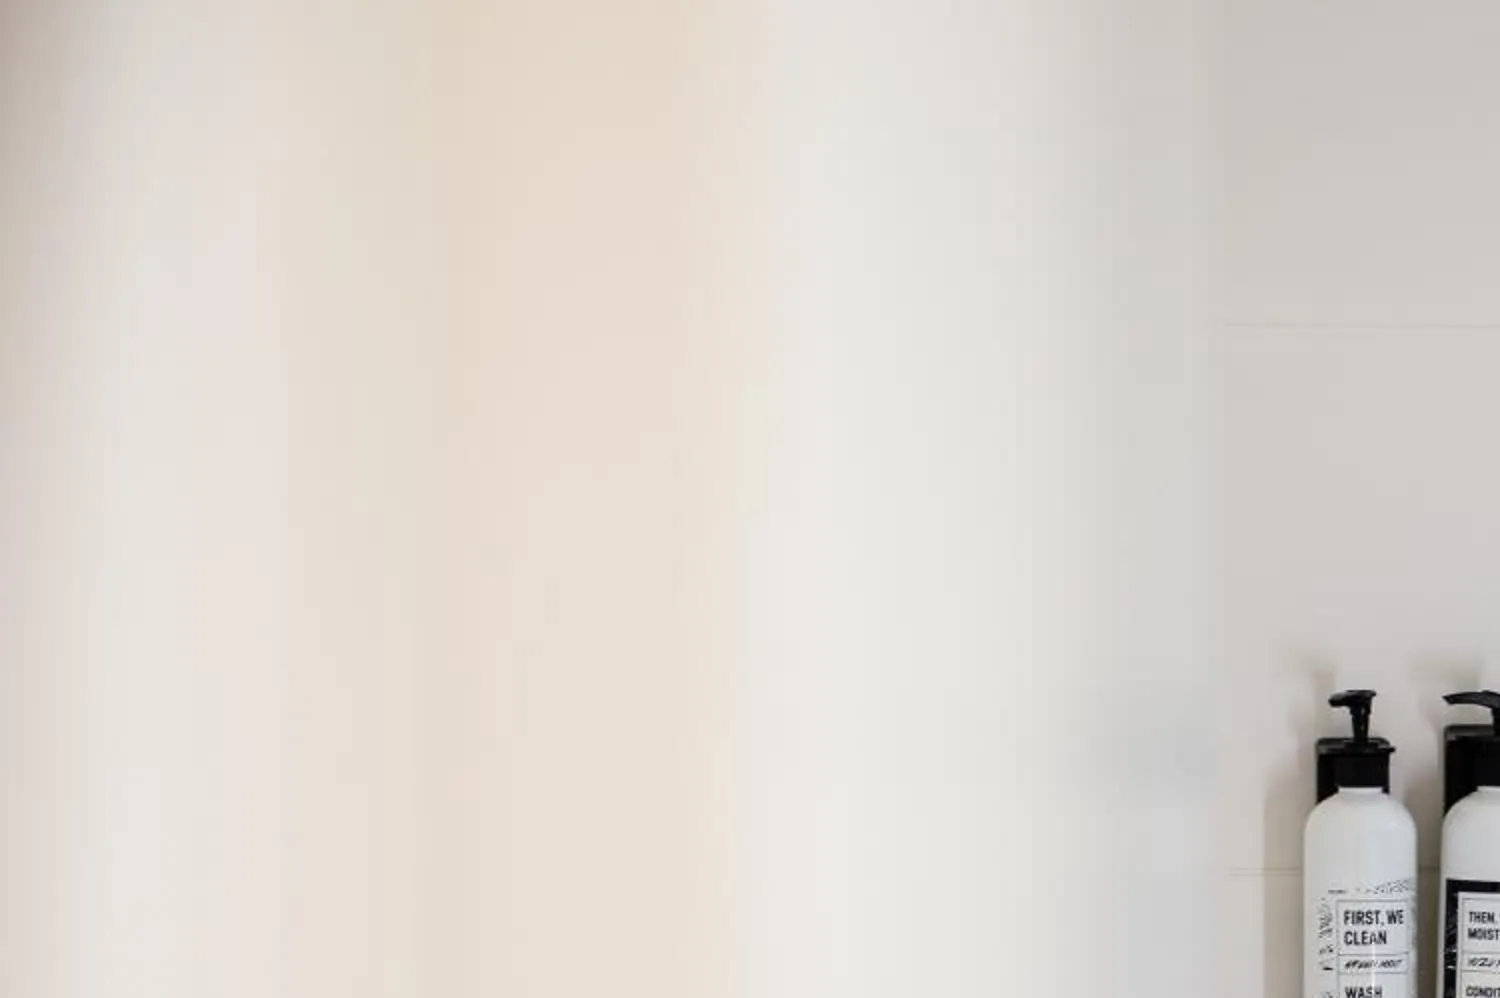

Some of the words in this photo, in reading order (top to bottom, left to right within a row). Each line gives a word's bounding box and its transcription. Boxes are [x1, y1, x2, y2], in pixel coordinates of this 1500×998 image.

[1343, 909, 1385, 926] FIRST,
[1386, 909, 1404, 925] WE
[1343, 930, 1387, 945] CLEAN
